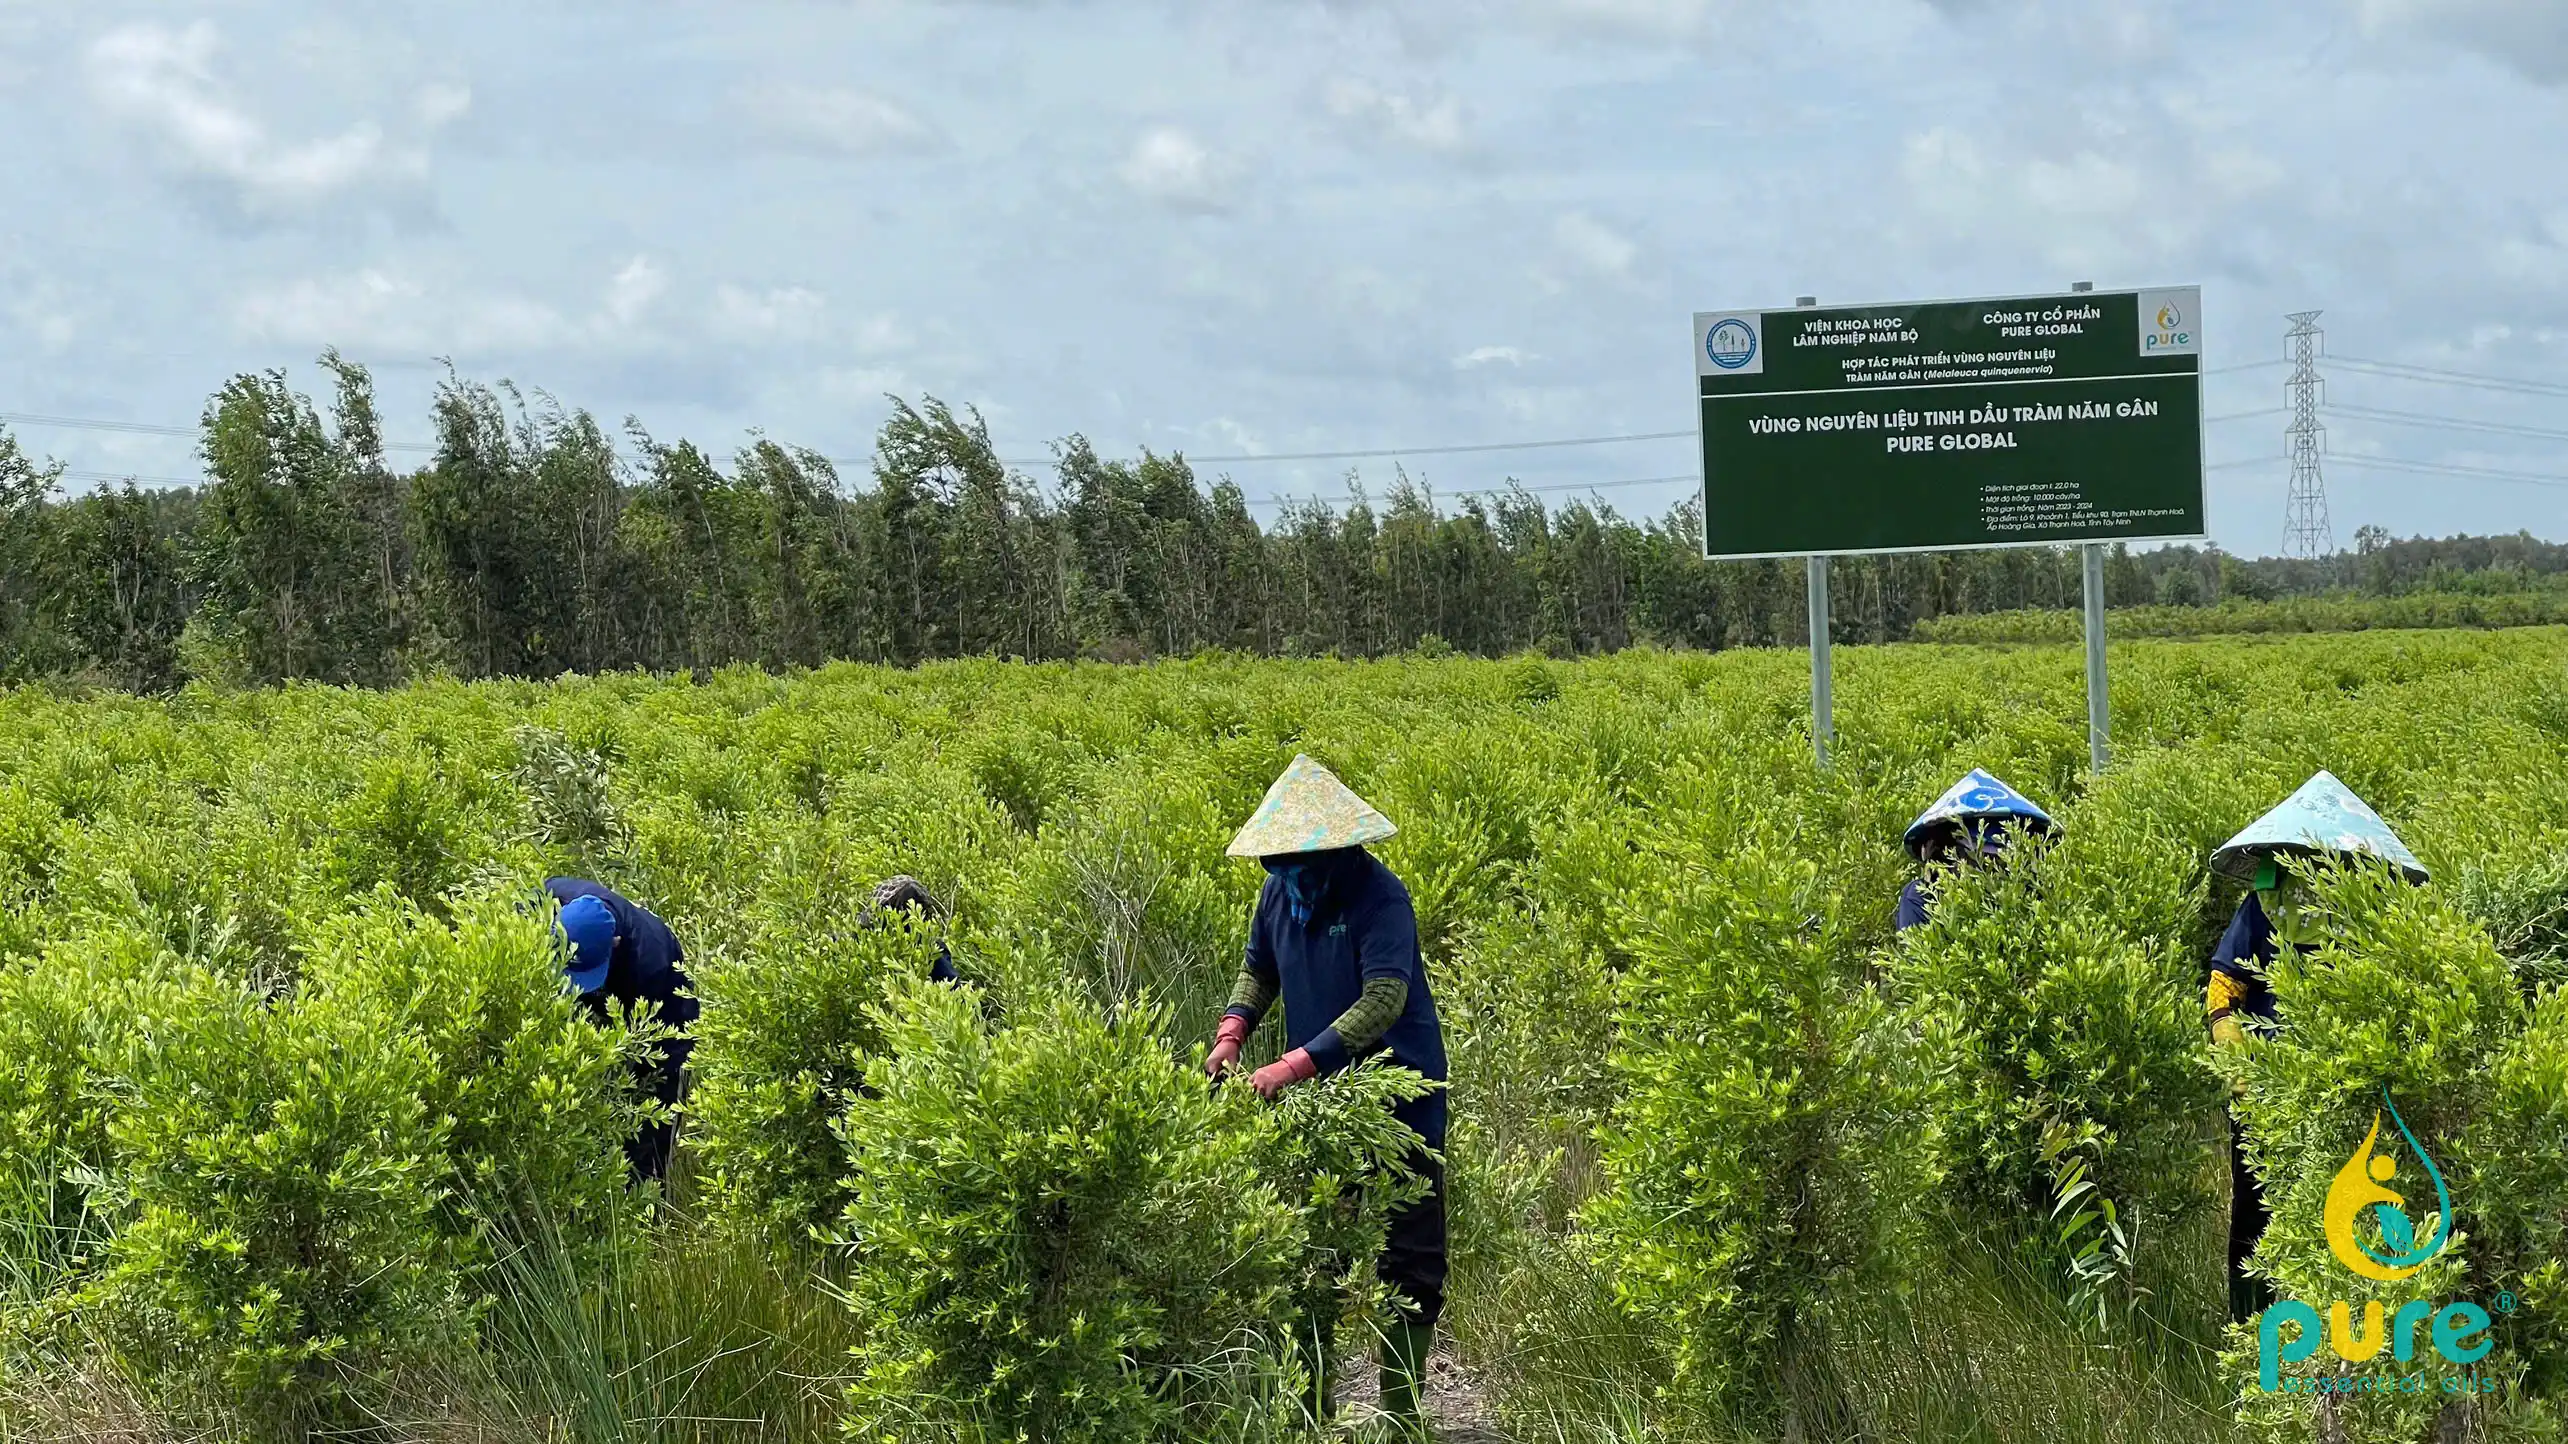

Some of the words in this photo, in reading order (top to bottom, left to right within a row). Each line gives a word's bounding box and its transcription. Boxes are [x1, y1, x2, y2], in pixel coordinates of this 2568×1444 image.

[1983, 311, 2022, 324] CÔNG
[2025, 311, 2039, 322] TY
[2042, 305, 2063, 321] CỔ
[2066, 304, 2100, 320] PHẦN
[1805, 319, 1831, 334] VIỆN
[1835, 319, 1870, 331] KHOA
[1874, 318, 1902, 331] HỌC
[2001, 325, 2031, 337] PURE
[2035, 323, 2083, 336] GLOBAL
[1793, 334, 1818, 346] LÂM
[1822, 331, 1866, 346] NGHIỆP
[1869, 331, 1897, 343] NAM
[1901, 328, 1919, 343] BỘ
[2147, 333, 2189, 350] pure
[1842, 359, 1866, 371] HỢP
[1868, 355, 1889, 367] TÁC
[1892, 354, 1919, 367] PHÁT
[1922, 351, 1950, 365] TRIỂN
[1953, 352, 1985, 364] VÙNG
[1988, 349, 2031, 362] NGUYÊN
[2035, 348, 2056, 361] LIỆU
[1846, 371, 1872, 382] TRÀM
[1874, 369, 1896, 381] NĂM
[1899, 368, 1921, 380] GÂN
[1923, 369, 1978, 381] (Melaleuca
[1981, 365, 2053, 378] quinquenervia)
[1749, 415, 1801, 434] VÙNG
[1806, 411, 1878, 431] NGUYÊN
[1884, 409, 1919, 431] LIỆU
[1924, 410, 1964, 426] TINH
[1970, 401, 2008, 424] DẦU
[2013, 402, 2063, 422] TRÀM
[2068, 400, 2110, 419] NĂM
[2116, 398, 2158, 417] GÂN
[1887, 435, 1934, 453] PURE
[1939, 432, 2017, 451] GLOBAL
